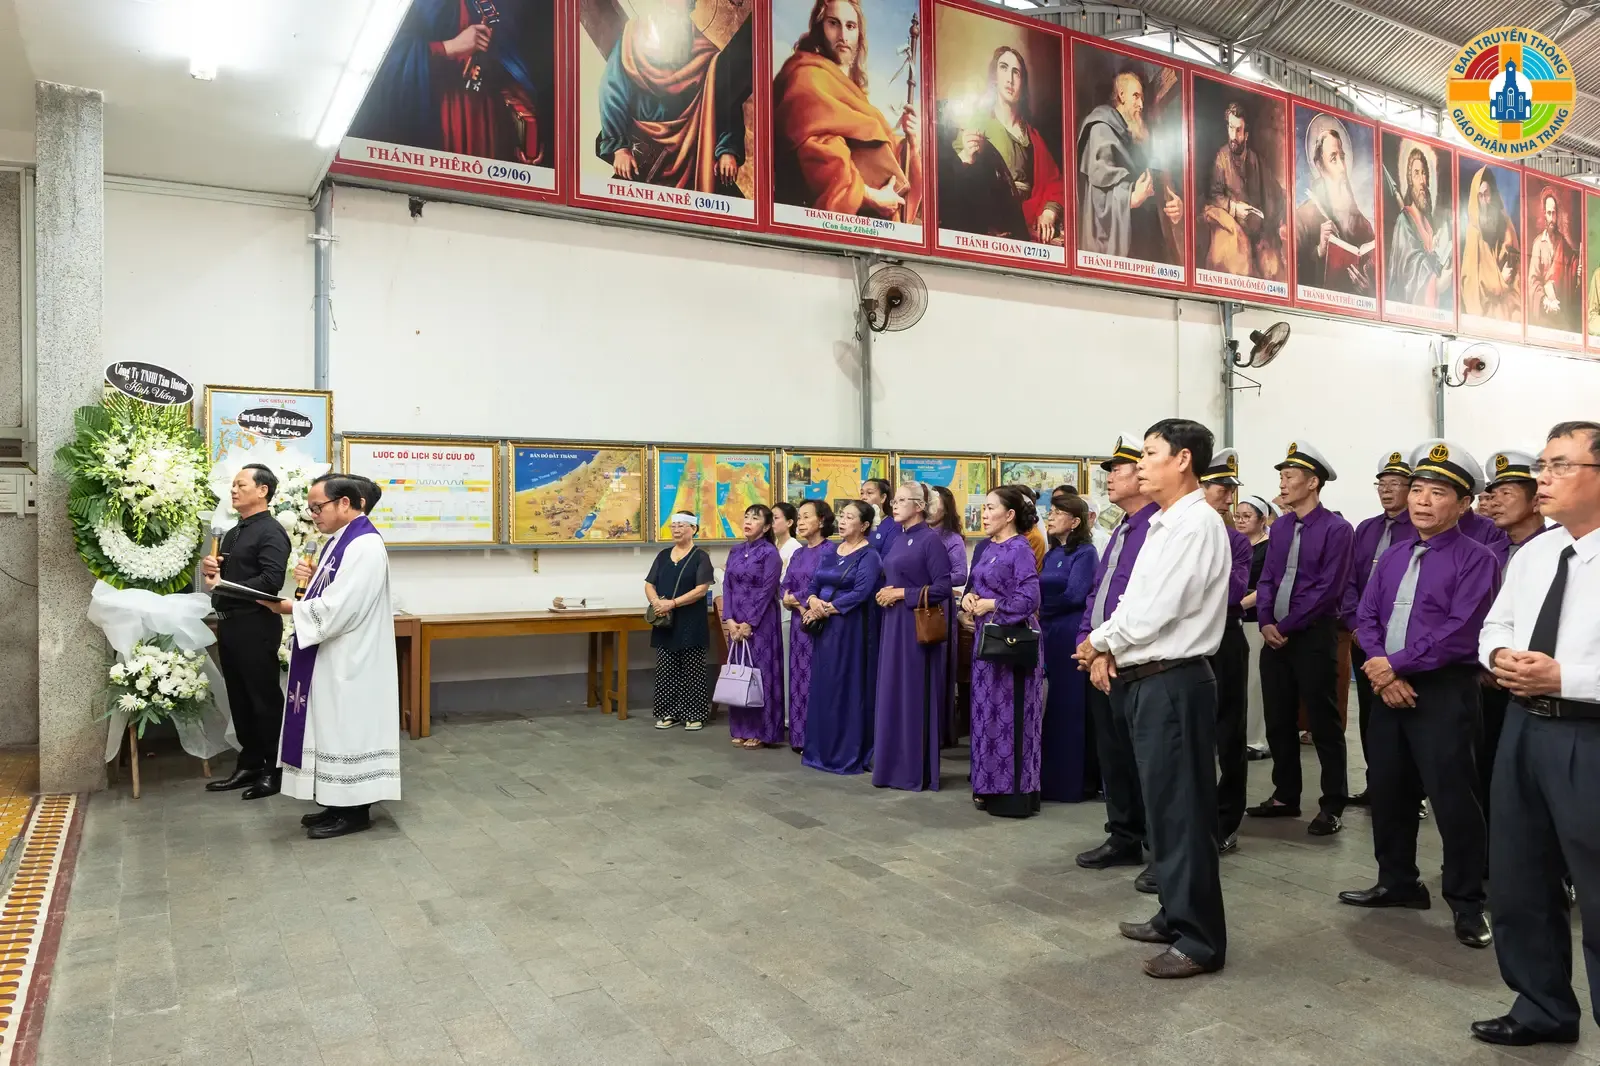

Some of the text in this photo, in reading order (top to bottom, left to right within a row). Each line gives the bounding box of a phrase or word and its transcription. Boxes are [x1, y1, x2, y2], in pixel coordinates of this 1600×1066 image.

[366, 146, 531, 184] THÁNH PHÊRÔ (29/06)
[607, 183, 730, 213] THÁNH ANRÊ (30/11)
[804, 208, 895, 231] THÁNH GIACÔBÊ (25/07)
[822, 220, 839, 229] (Con
[955, 235, 1050, 259] THÁNH GIOAN (27/12)
[1082, 255, 1180, 279] THÁNH PHILIPPHÊ (03/05)
[1198, 272, 1223, 284] THÁNH
[1303, 288, 1325, 300] THÁNH
[114, 362, 131, 381] Công
[131, 366, 140, 380] Ty
[140, 369, 158, 384] TNHH
[411, 451, 430, 461] LỊCH
